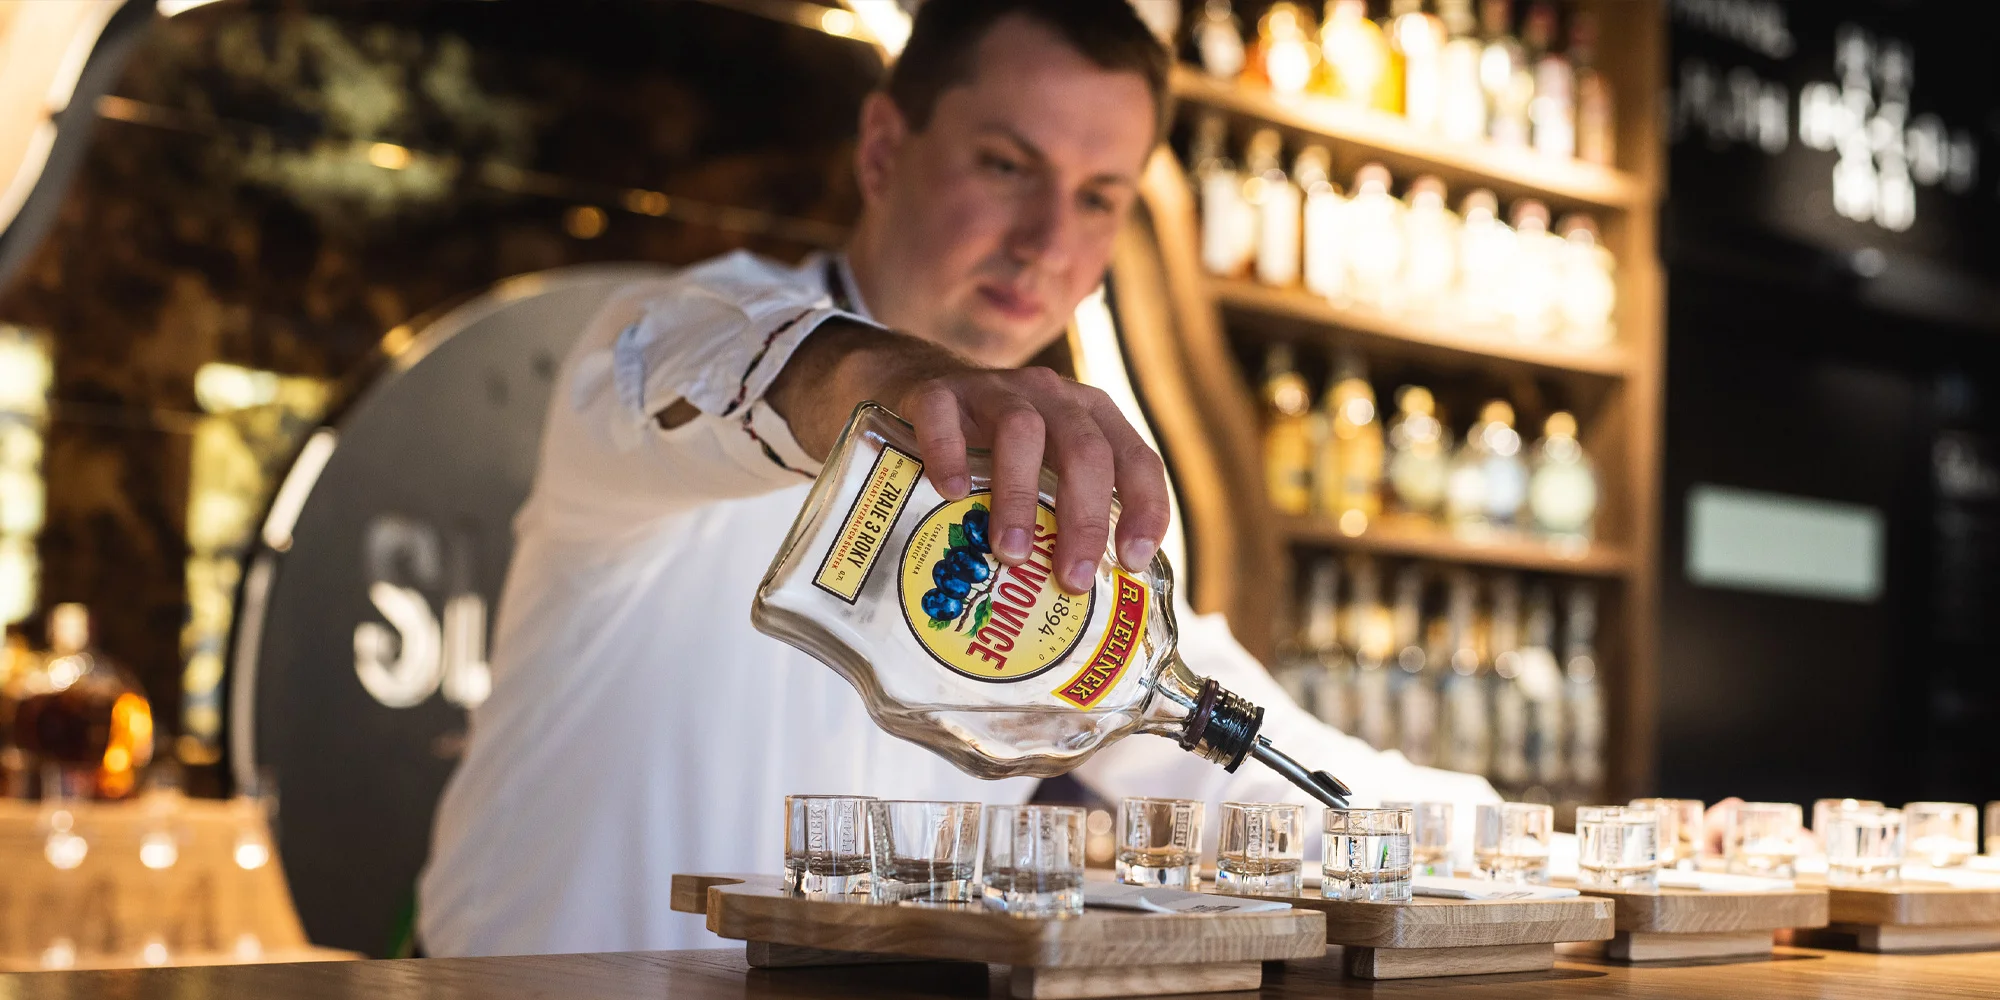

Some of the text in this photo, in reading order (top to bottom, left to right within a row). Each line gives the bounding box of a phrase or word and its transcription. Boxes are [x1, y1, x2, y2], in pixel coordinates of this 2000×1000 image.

[847, 481, 902, 569] ZRAJE 3 ROKY
[911, 532, 929, 560] VIZOVICE
[911, 544, 933, 575] REPUBLIKA
[1070, 582, 1139, 700] R. JELÍNEK
